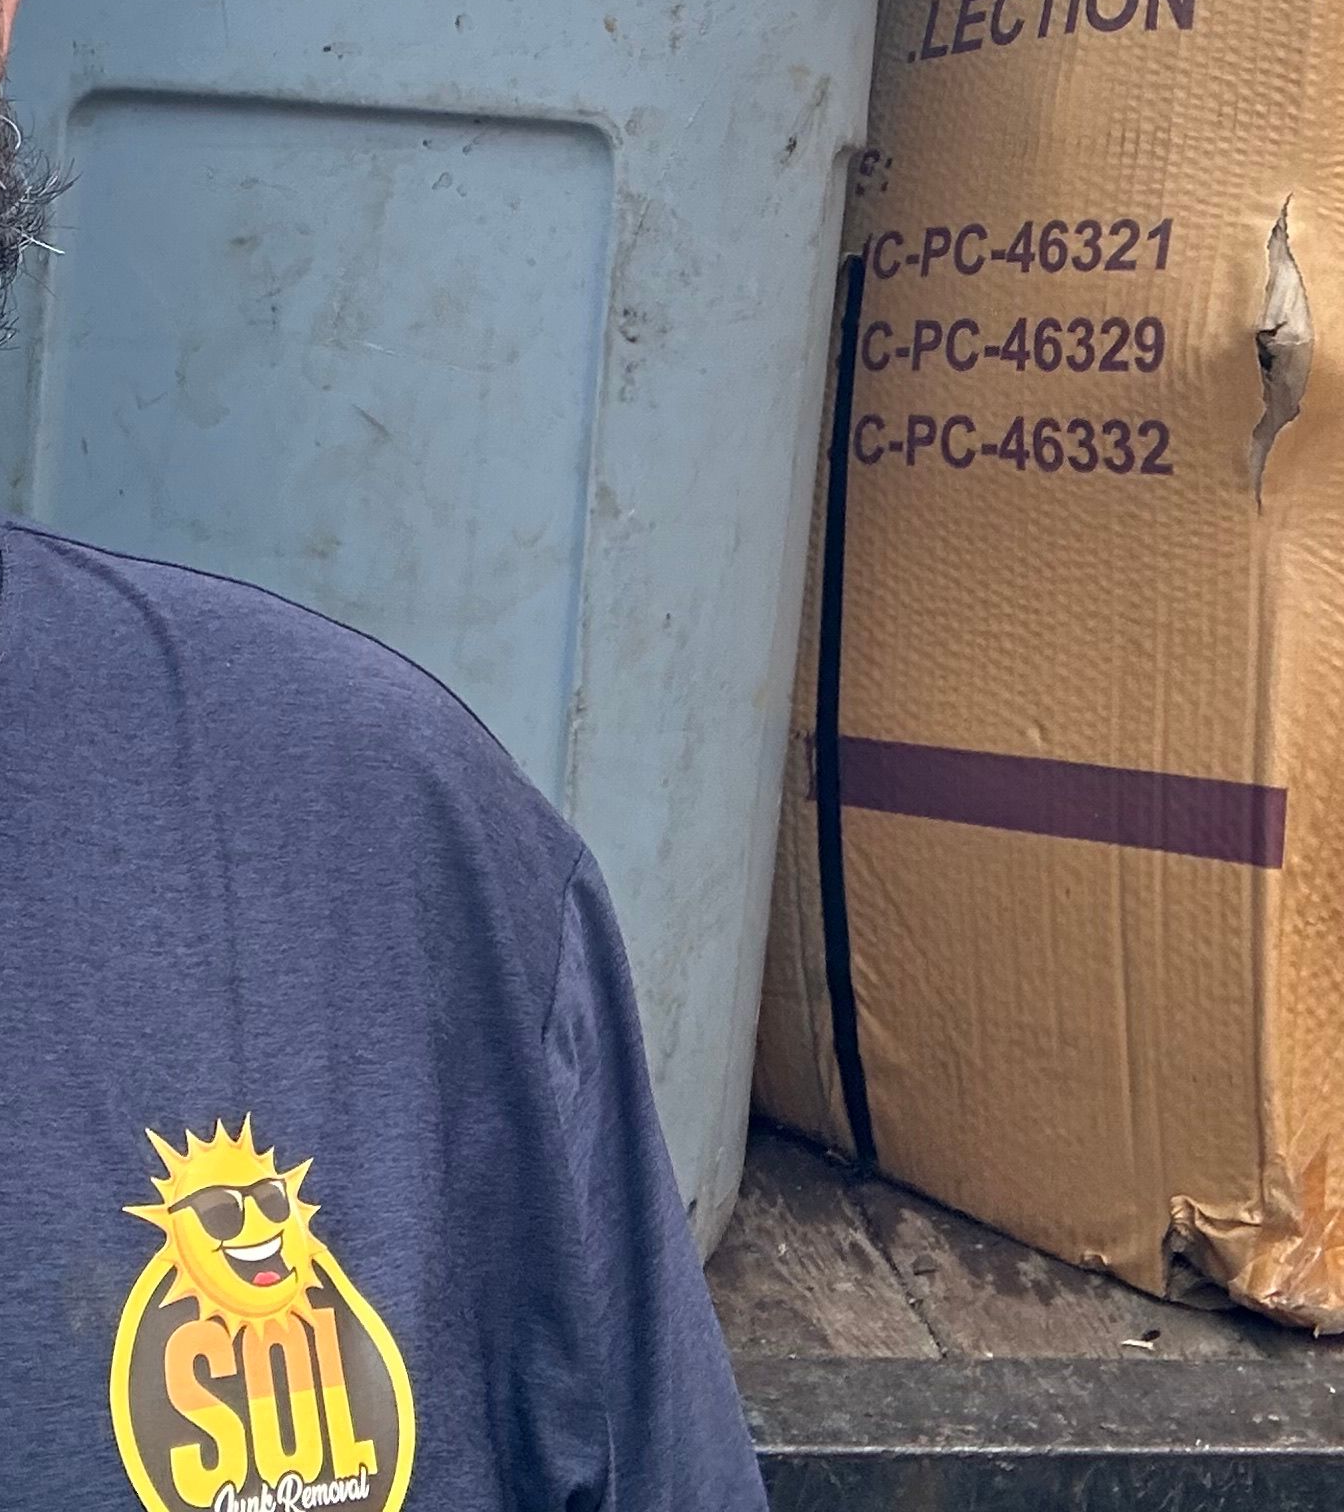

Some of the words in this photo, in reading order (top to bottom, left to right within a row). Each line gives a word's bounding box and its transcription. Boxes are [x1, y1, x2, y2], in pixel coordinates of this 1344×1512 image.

[863, 217, 1174, 280] C-PC-46321
[164, 1308, 378, 1508] SOL
[276, 1465, 370, 1512] Removal
